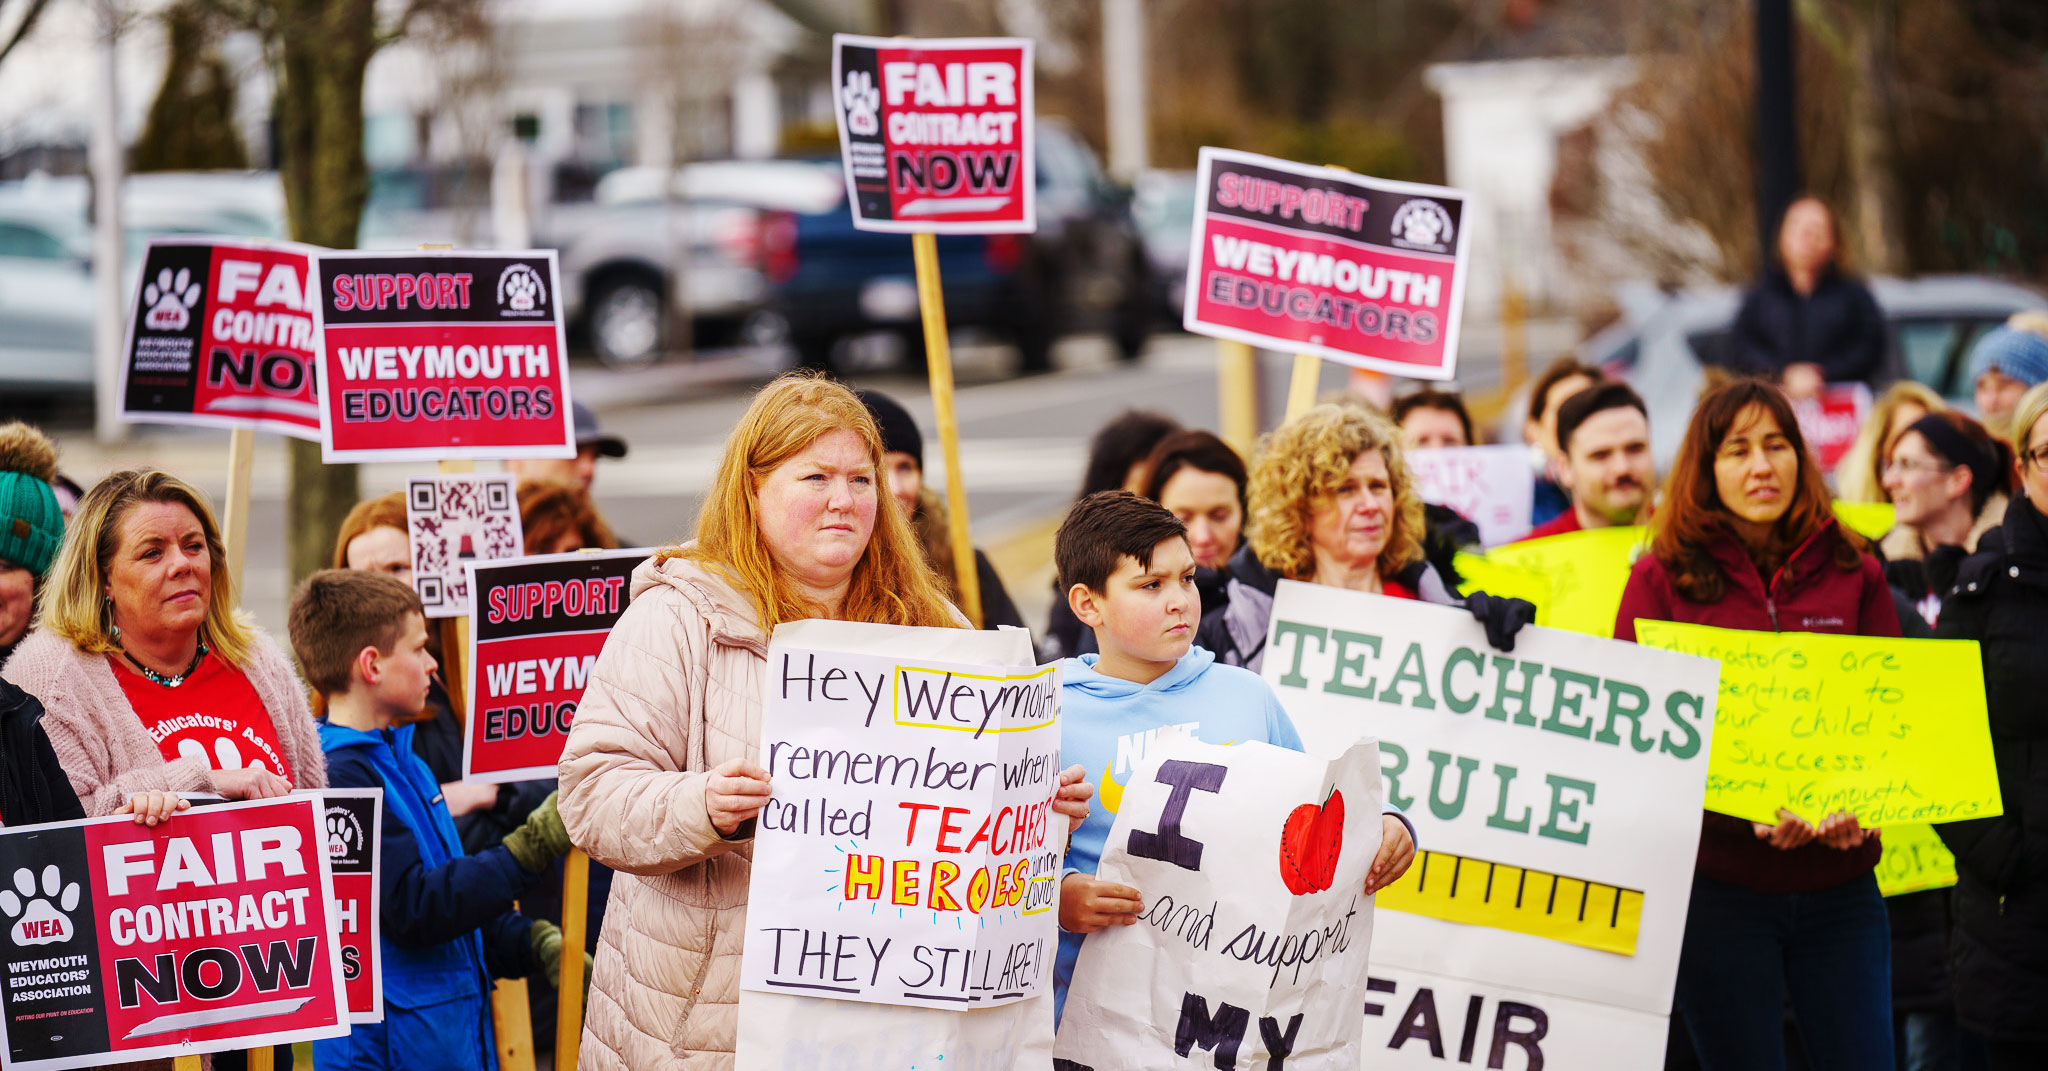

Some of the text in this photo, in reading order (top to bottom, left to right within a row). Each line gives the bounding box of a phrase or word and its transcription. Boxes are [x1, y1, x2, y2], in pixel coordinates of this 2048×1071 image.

[884, 62, 1016, 107] FAIR
[888, 111, 1017, 145] CONTRACT
[892, 151, 1018, 194] NOW
[1217, 172, 1370, 232] SUPPORT
[333, 272, 473, 311] SUPPORT
[1211, 234, 1441, 307] WEYMOUTH
[1207, 270, 1438, 345] EDUCATORS
[337, 344, 550, 380] WEYMOUTH
[342, 385, 554, 422] EDUCATORS
[488, 576, 624, 624] SUPPORT
[1840, 650, 1901, 672] are
[782, 653, 885, 728] Hey
[1273, 620, 1703, 760] TEACHERS
[1865, 677, 1904, 704] to
[148, 712, 237, 743] Educators'
[769, 740, 997, 791] remember
[1003, 747, 1049, 790] when
[1127, 759, 1228, 872] I
[1378, 741, 1596, 846] RULE
[1786, 779, 1924, 814] Weymouth
[329, 845, 343, 853] WEA
[763, 797, 1052, 855] called TEACHERS
[102, 825, 308, 896] FAIR
[844, 853, 1029, 914] HEROES
[22, 918, 64, 940] WEA
[109, 887, 310, 946] CONTRACT
[8, 955, 88, 973] WEYMOUTH
[760, 928, 891, 986] THEY
[899, 945, 995, 992] STILL
[1137, 894, 1357, 989] and support
[9, 970, 90, 988] EDUCATORS'
[12, 985, 91, 1002] ASSOCIATION
[114, 936, 318, 1010] NOW
[68, 1007, 94, 1015] EDUCATION
[1175, 991, 1304, 1071] MY
